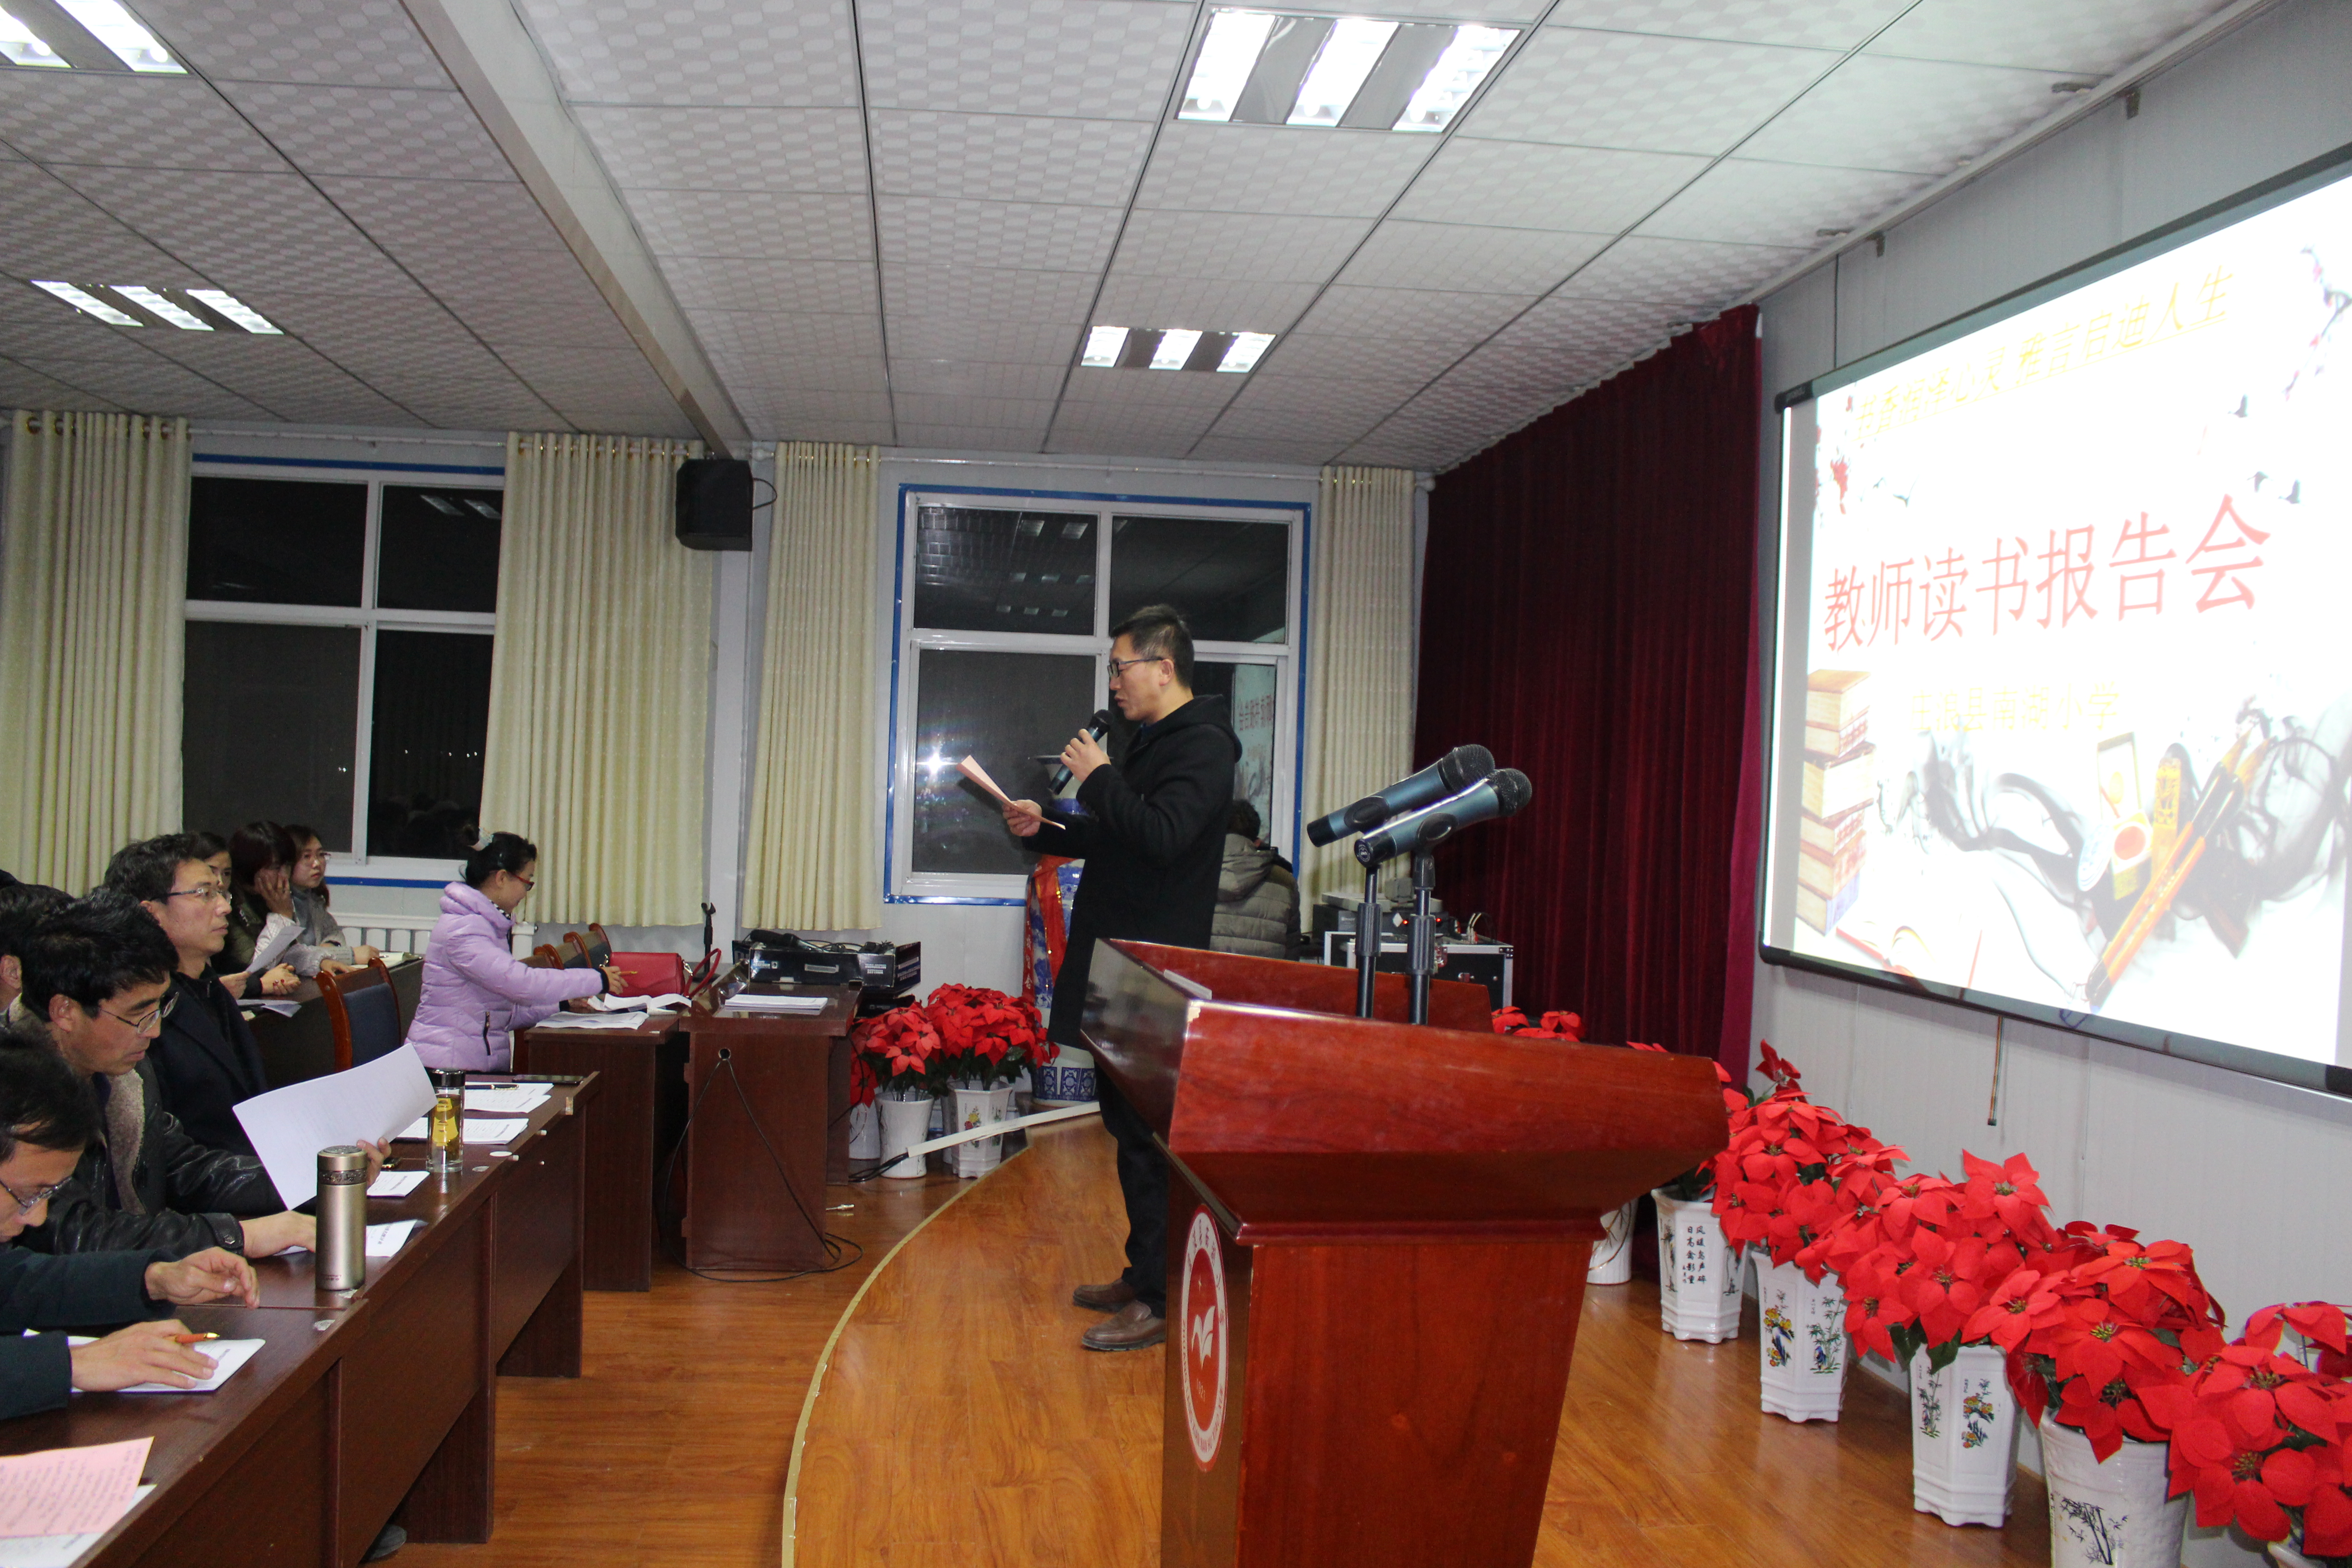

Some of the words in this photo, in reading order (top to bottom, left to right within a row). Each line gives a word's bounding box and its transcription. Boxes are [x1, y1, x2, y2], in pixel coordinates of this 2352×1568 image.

[1855, 346, 2006, 439] 书香润泽心灵
[2015, 265, 2234, 387] 雅言启迪人生
[1823, 493, 2271, 654] 教师读书报告会
[1909, 681, 2120, 732] 庄浪县南湖小学
[1196, 1378, 1205, 1402] 1921
